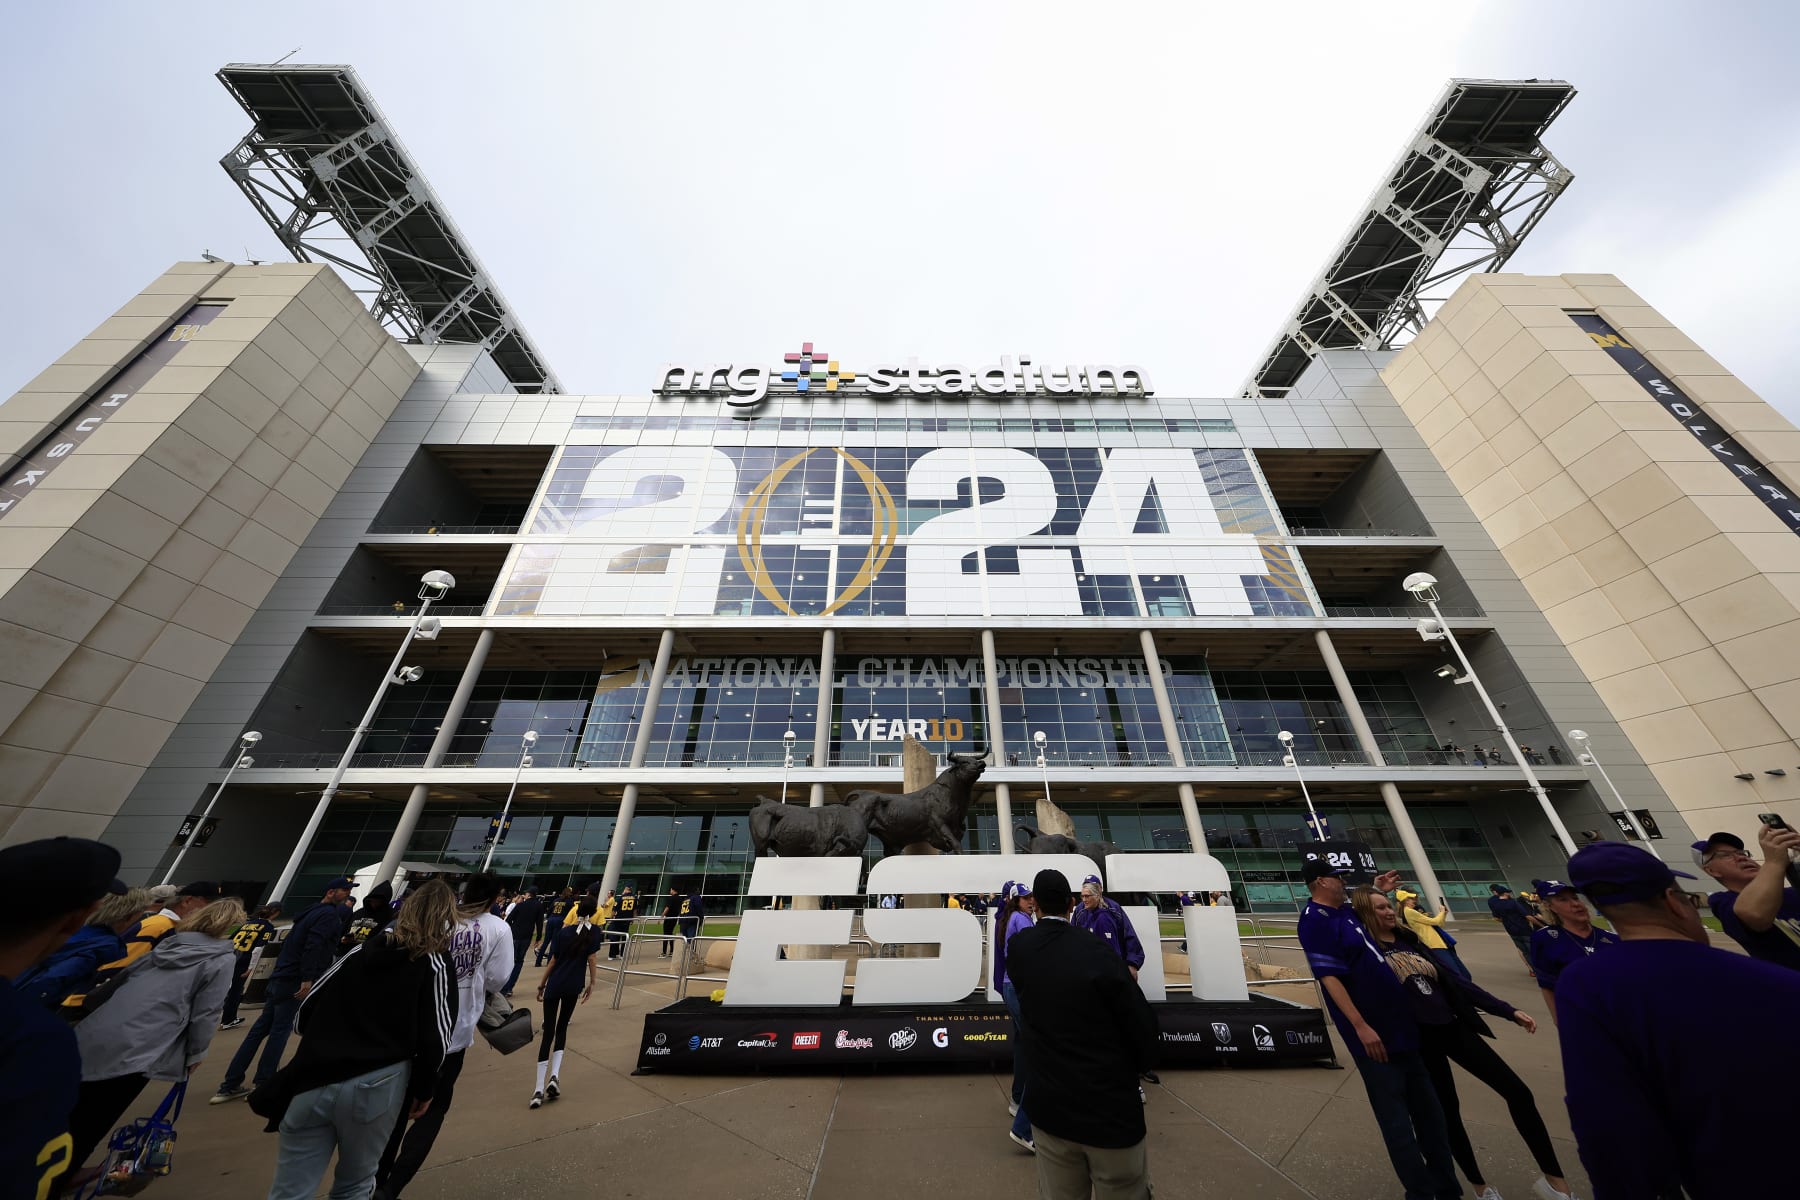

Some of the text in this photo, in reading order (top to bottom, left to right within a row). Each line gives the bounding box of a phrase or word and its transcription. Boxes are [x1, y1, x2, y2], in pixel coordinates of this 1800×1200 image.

[652, 355, 1155, 407] nrg stadium
[1162, 1031, 1202, 1042] Prudential
[701, 1037, 723, 1048] AT&T
[645, 1046, 671, 1055] Allstate
